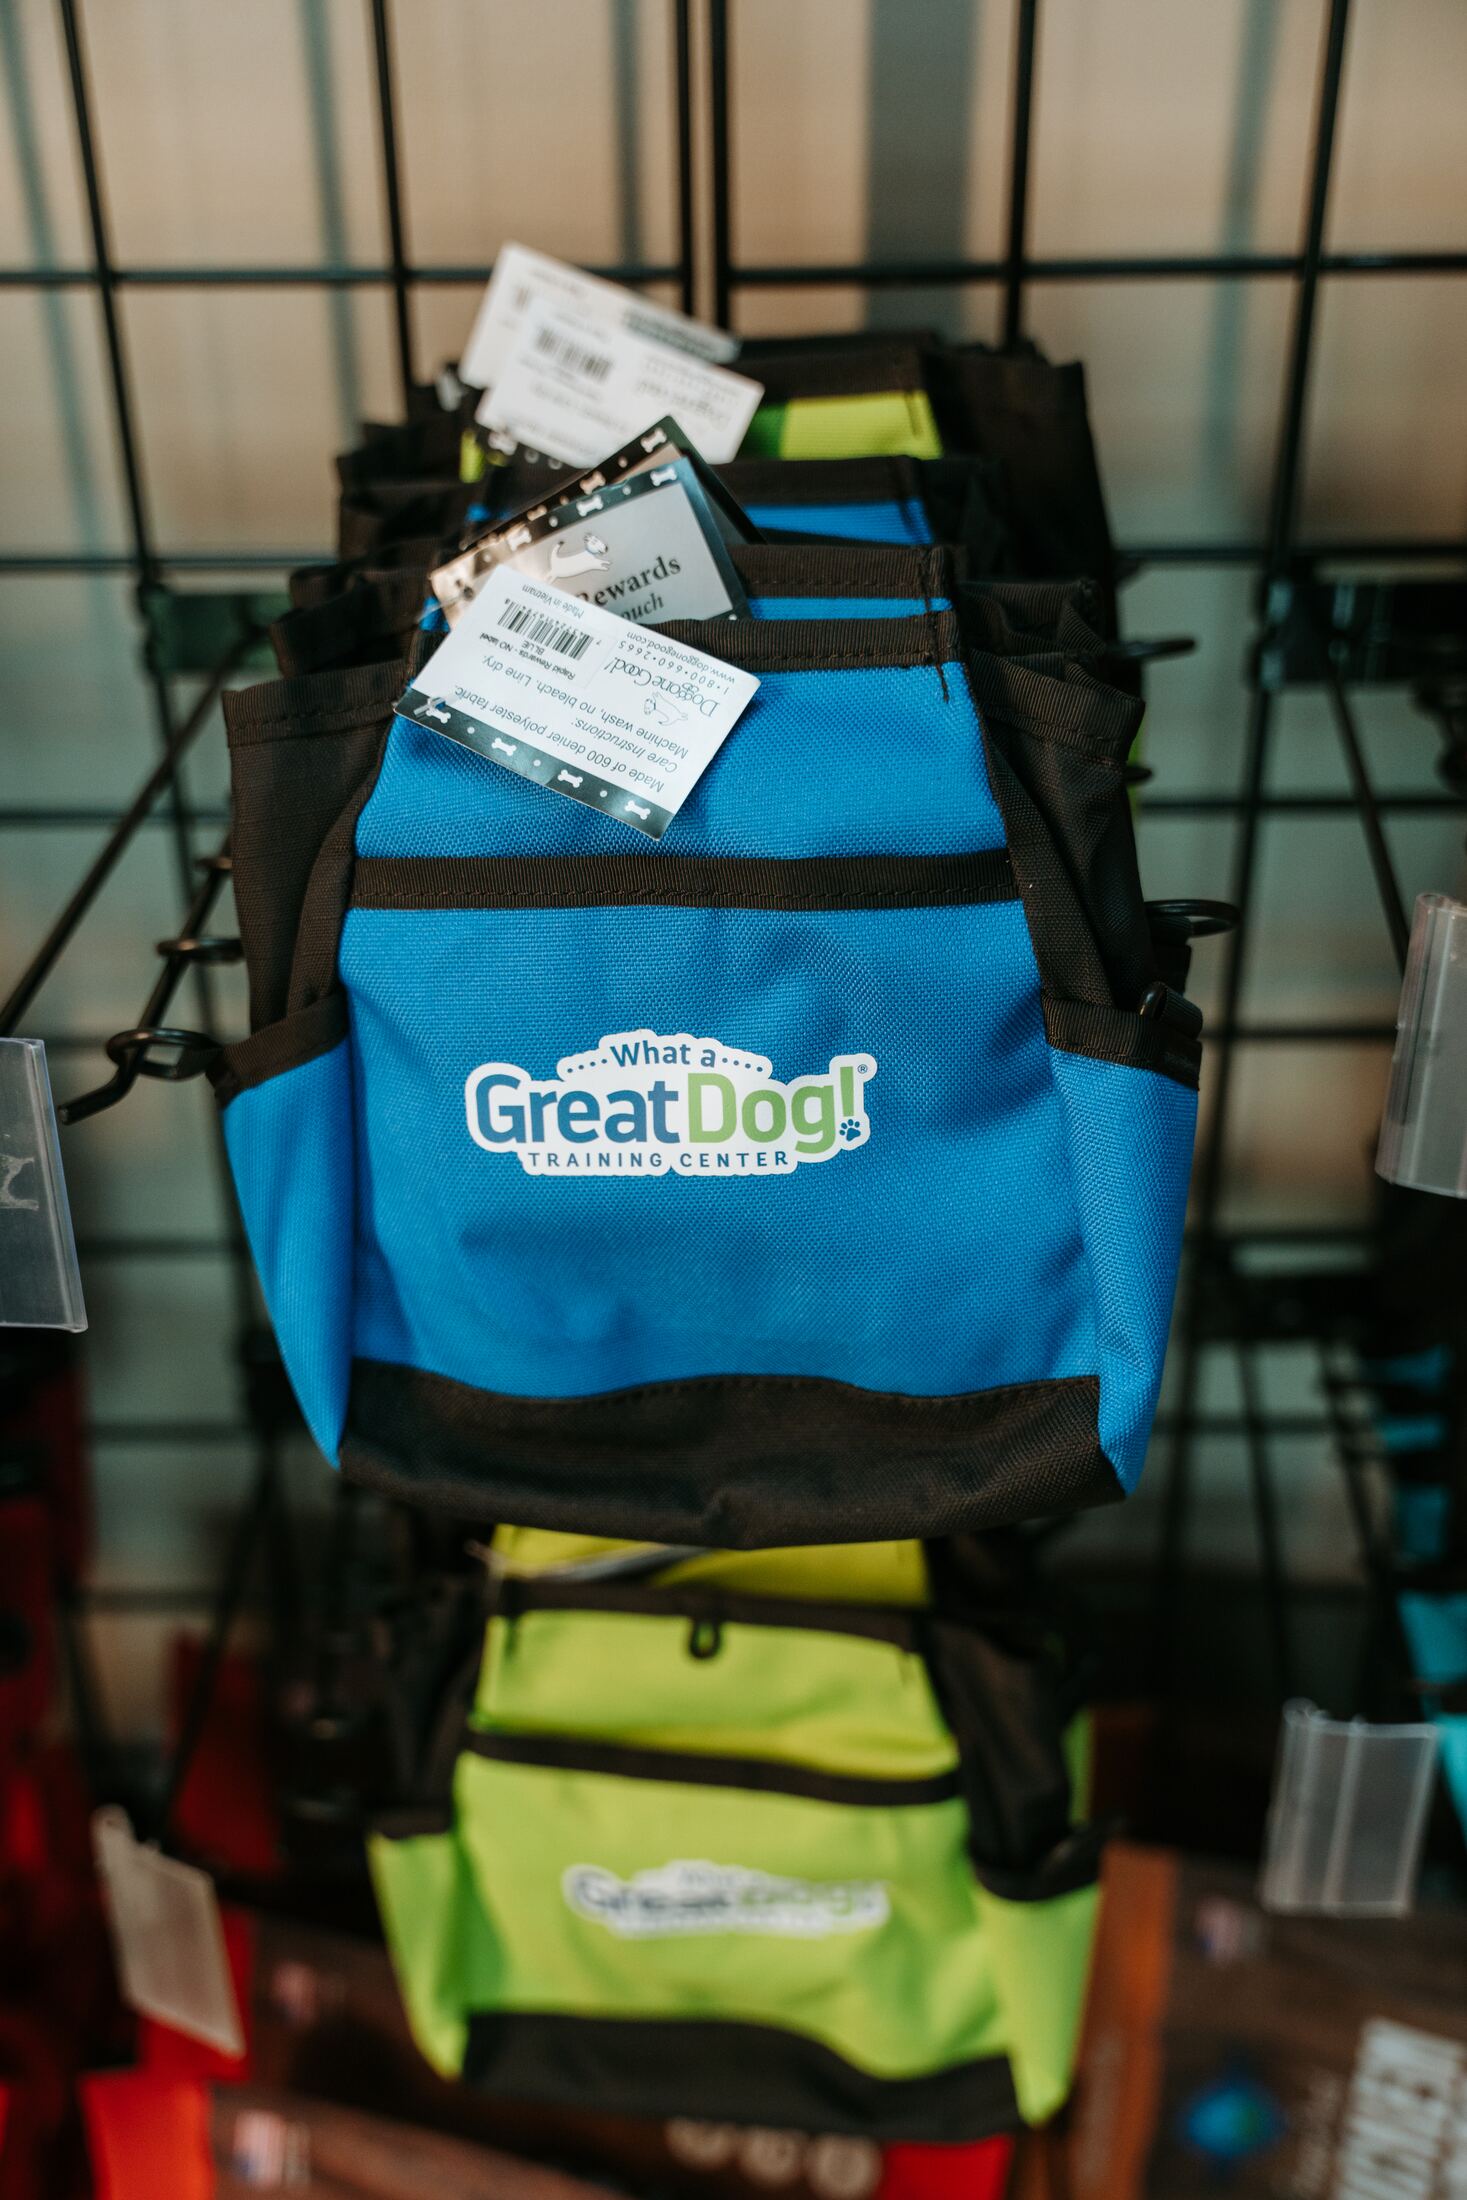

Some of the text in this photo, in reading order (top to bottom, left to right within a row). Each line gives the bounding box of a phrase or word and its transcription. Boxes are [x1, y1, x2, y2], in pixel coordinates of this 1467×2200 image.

[521, 584, 585, 620] Made in Vietnam
[621, 592, 664, 624] ouch
[479, 632, 500, 646] label
[498, 641, 514, 653] NO
[521, 639, 546, 656] BLUE
[518, 649, 553, 670] Rewards
[551, 664, 576, 681] Rapid
[626, 631, 735, 690] www.doggonegood.com
[481, 655, 689, 760] Machine wash, no bleach. Line dry.
[454, 685, 665, 793] Made of 600 denier polyester fabric.
[570, 717, 678, 774] Care Instructions:
[610, 1040, 716, 1068] What a
[528, 1151, 789, 1168] TRAINING CENTER
